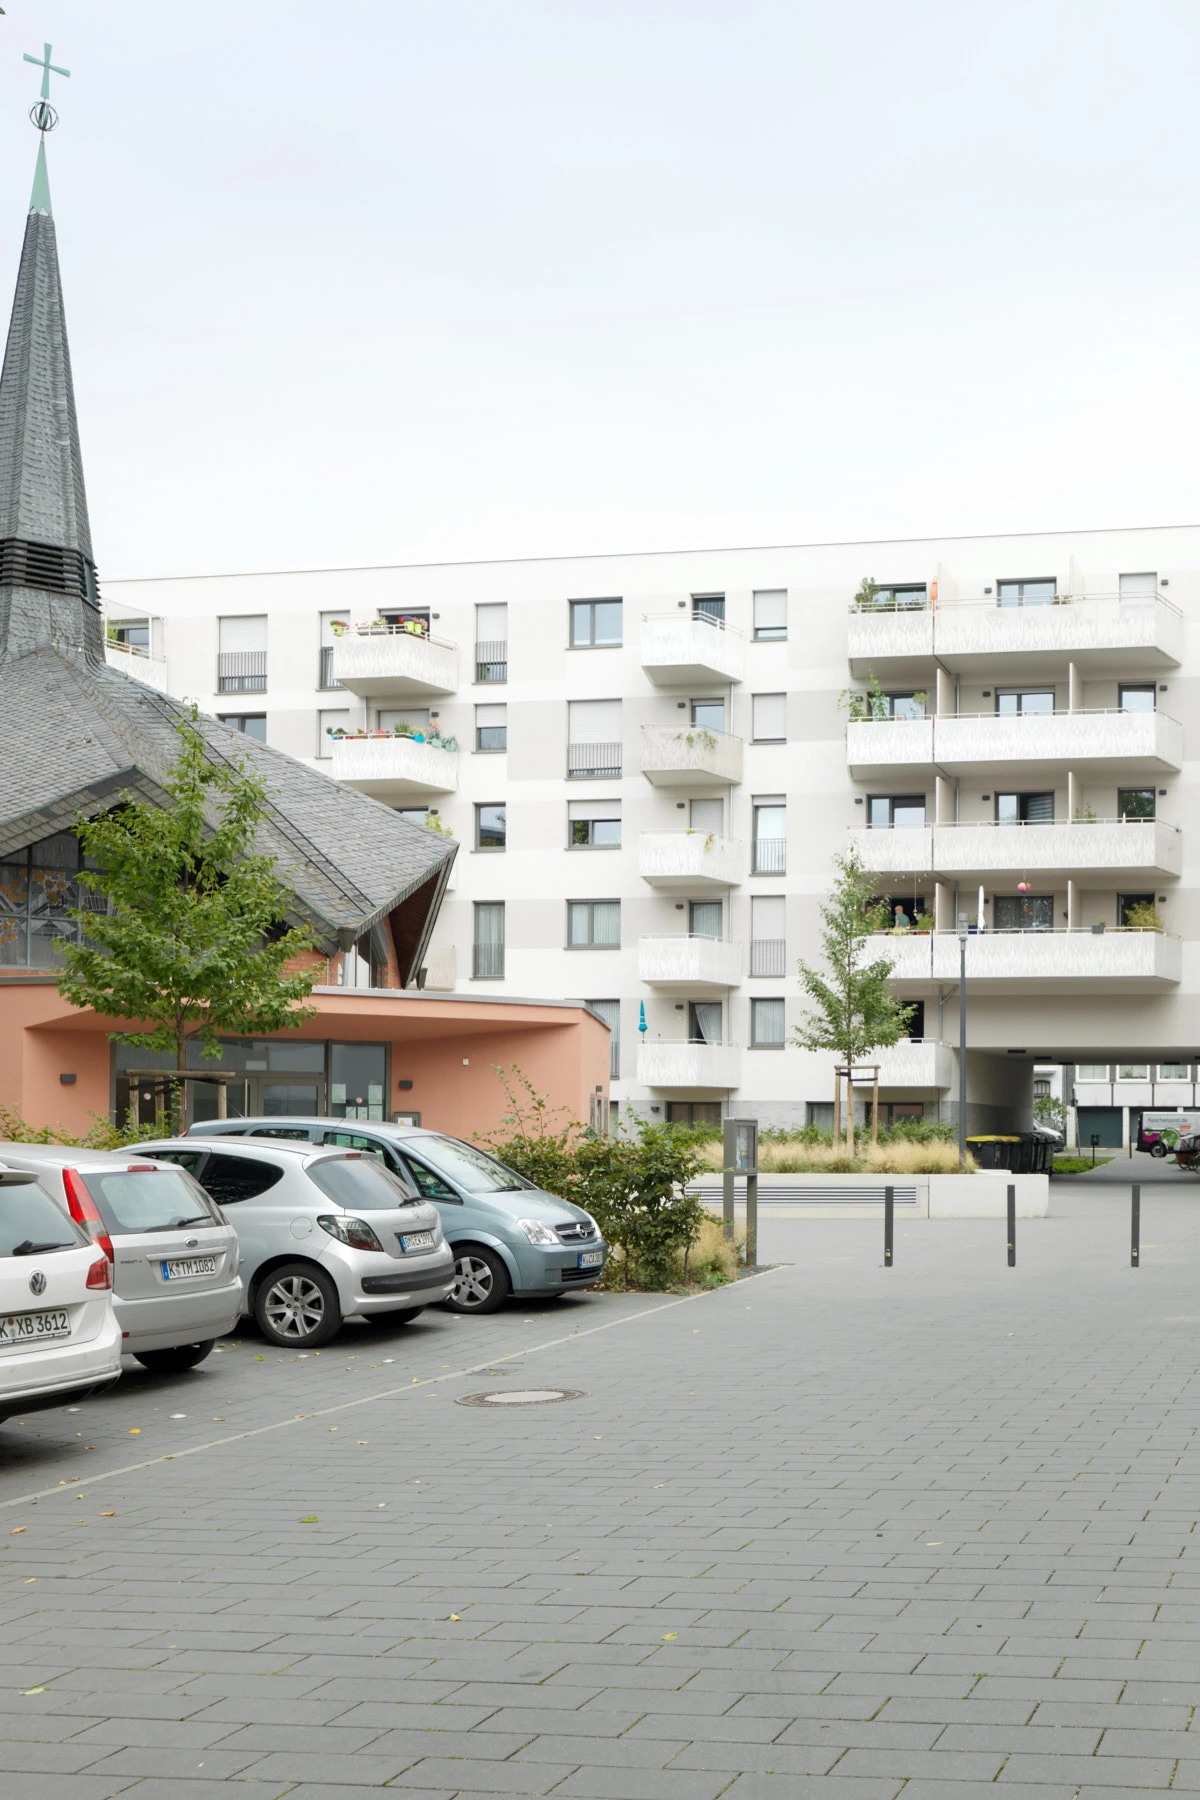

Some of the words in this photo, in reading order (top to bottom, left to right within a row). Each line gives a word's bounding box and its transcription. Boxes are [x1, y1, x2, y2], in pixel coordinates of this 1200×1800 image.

[169, 1262, 176, 1277] K
[181, 1261, 194, 1275] TM
[194, 1259, 215, 1274] 1082
[0, 1320, 9, 1338] K
[16, 1317, 35, 1335] XB
[35, 1313, 68, 1332] 3612
